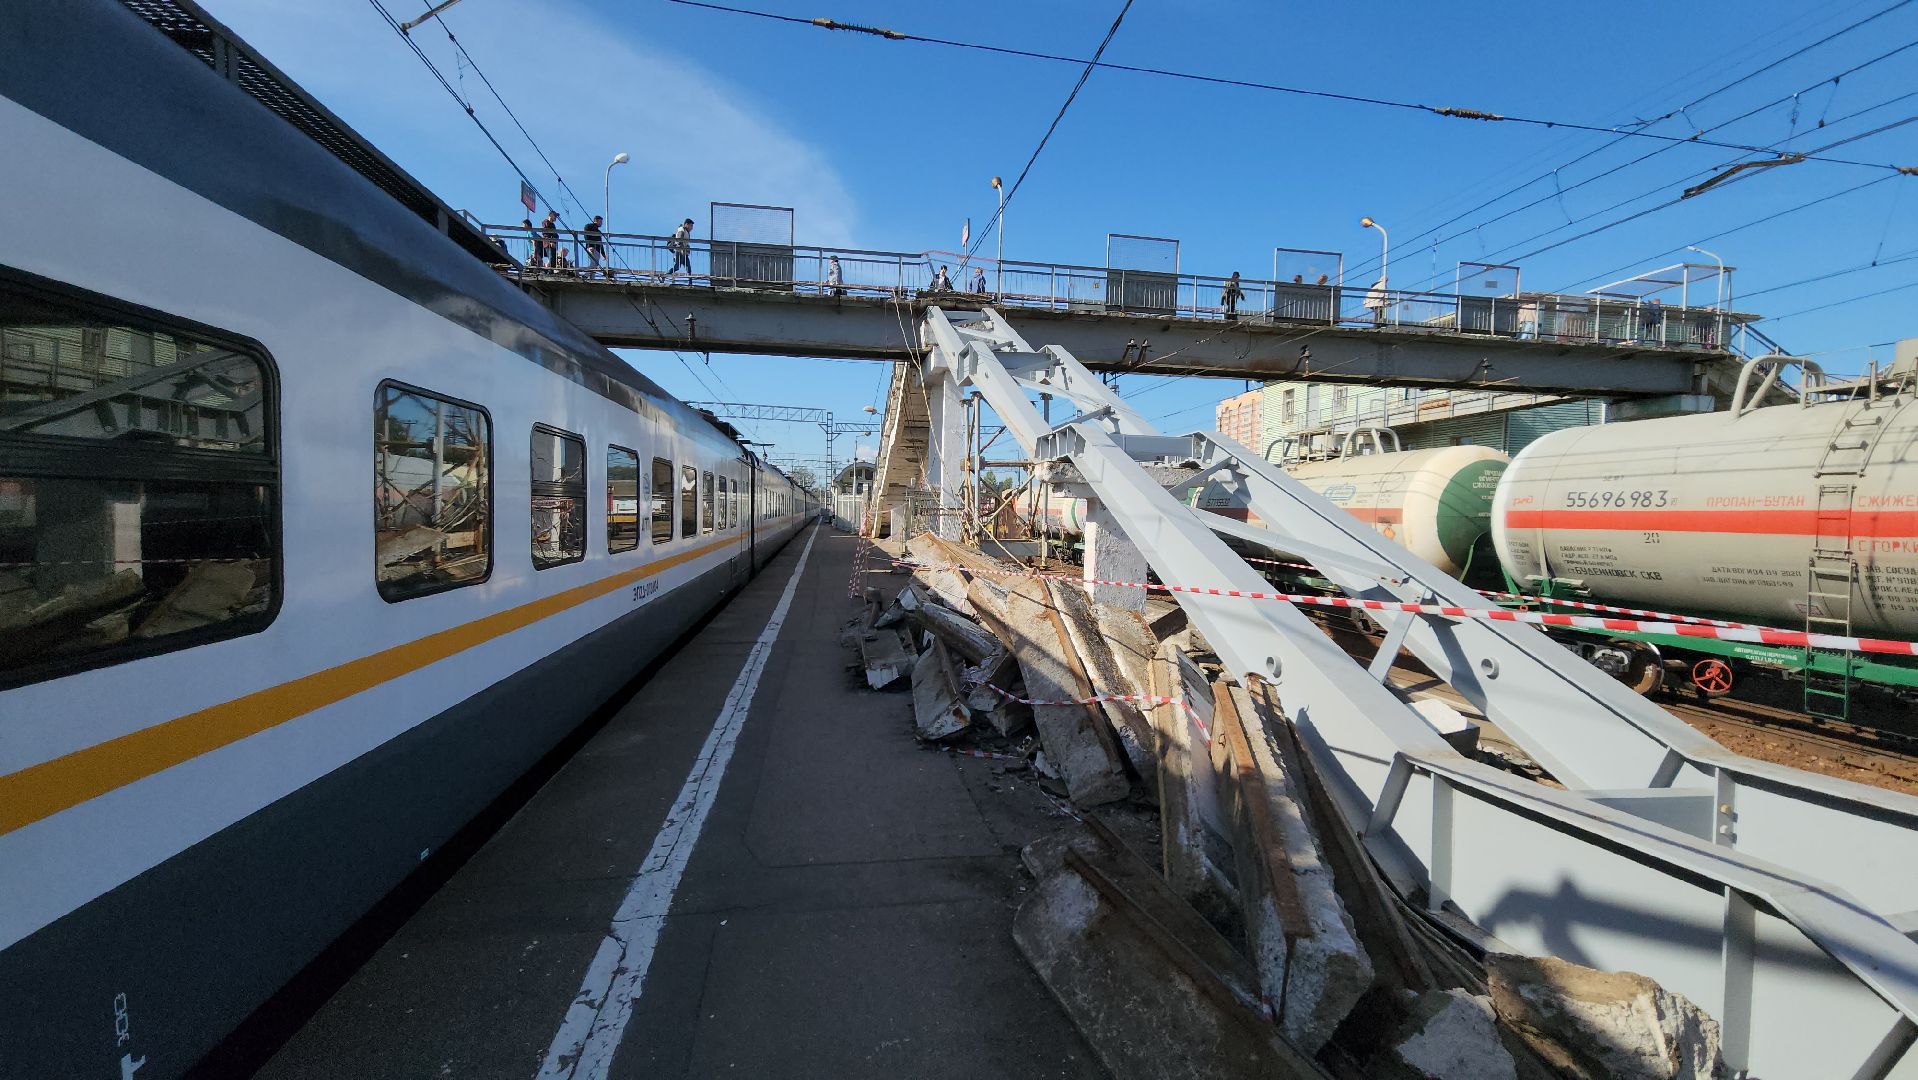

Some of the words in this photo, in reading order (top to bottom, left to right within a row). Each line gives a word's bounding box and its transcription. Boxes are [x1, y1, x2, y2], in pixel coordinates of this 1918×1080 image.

[1566, 490, 1669, 508] 55696983
[1706, 496, 1805, 508] ПРОПАН-БУТАН
[1857, 494, 1918, 508] СЖИЖЕ
